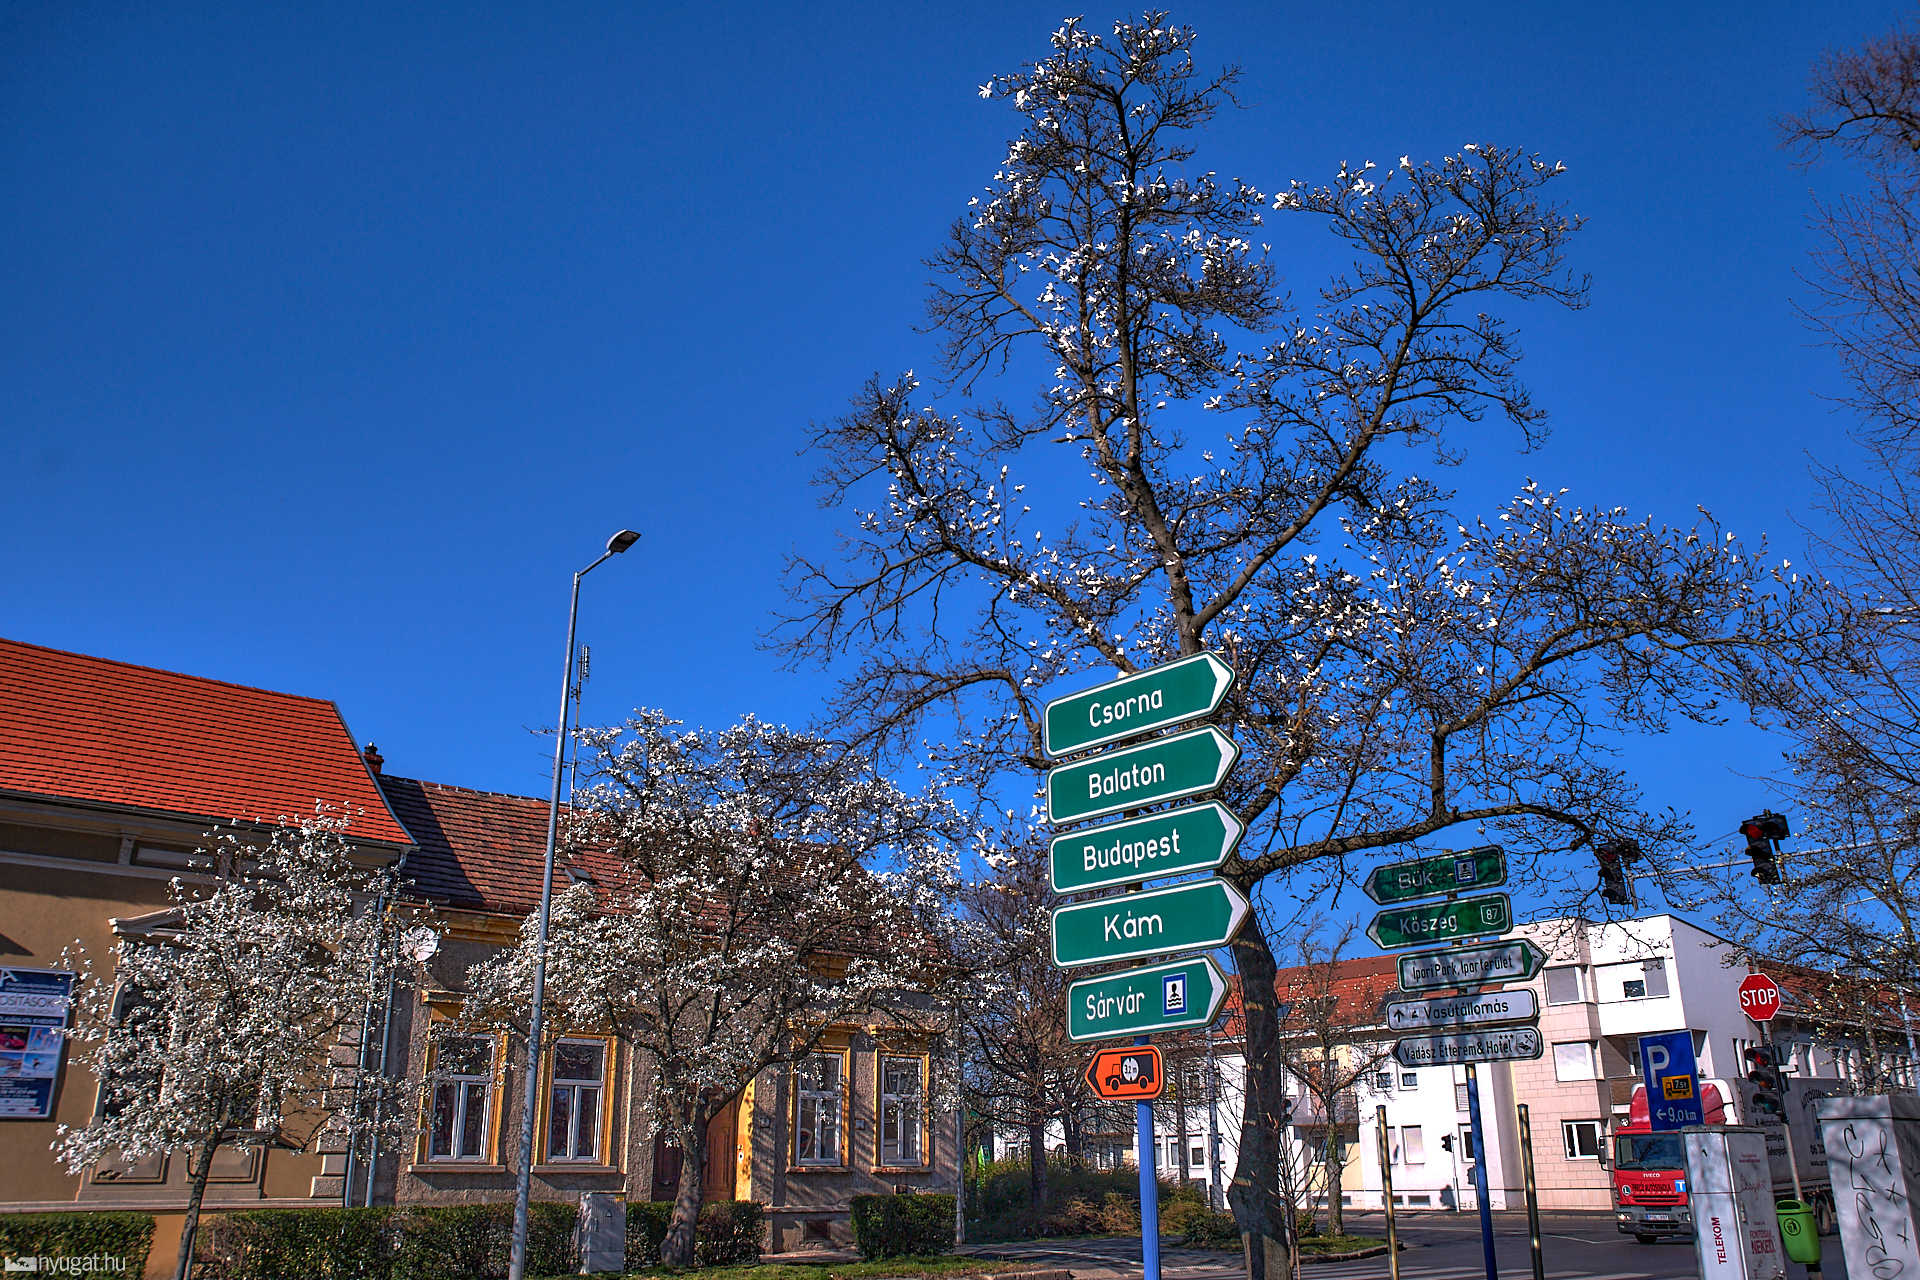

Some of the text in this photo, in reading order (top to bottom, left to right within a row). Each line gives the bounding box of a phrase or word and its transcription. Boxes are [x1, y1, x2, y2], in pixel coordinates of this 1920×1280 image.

[1089, 689, 1163, 727] Csorna
[1089, 762, 1165, 799] Balaton
[1083, 828, 1180, 871] Budapest
[1398, 870, 1433, 889] Bük
[1104, 910, 1163, 941] Kám
[1400, 914, 1458, 935] Kőszeg
[1486, 908, 1498, 920] 87
[1086, 986, 1145, 1020] Sárvár
[1424, 999, 1509, 1019] Vasútállomás
[1741, 988, 1776, 1006] STOP
[1404, 1046, 1436, 1060] Vadász
[1486, 1040, 1513, 1055] Hotel
[1646, 1045, 1670, 1088] P
[1711, 1217, 1727, 1264] TELEKOM
